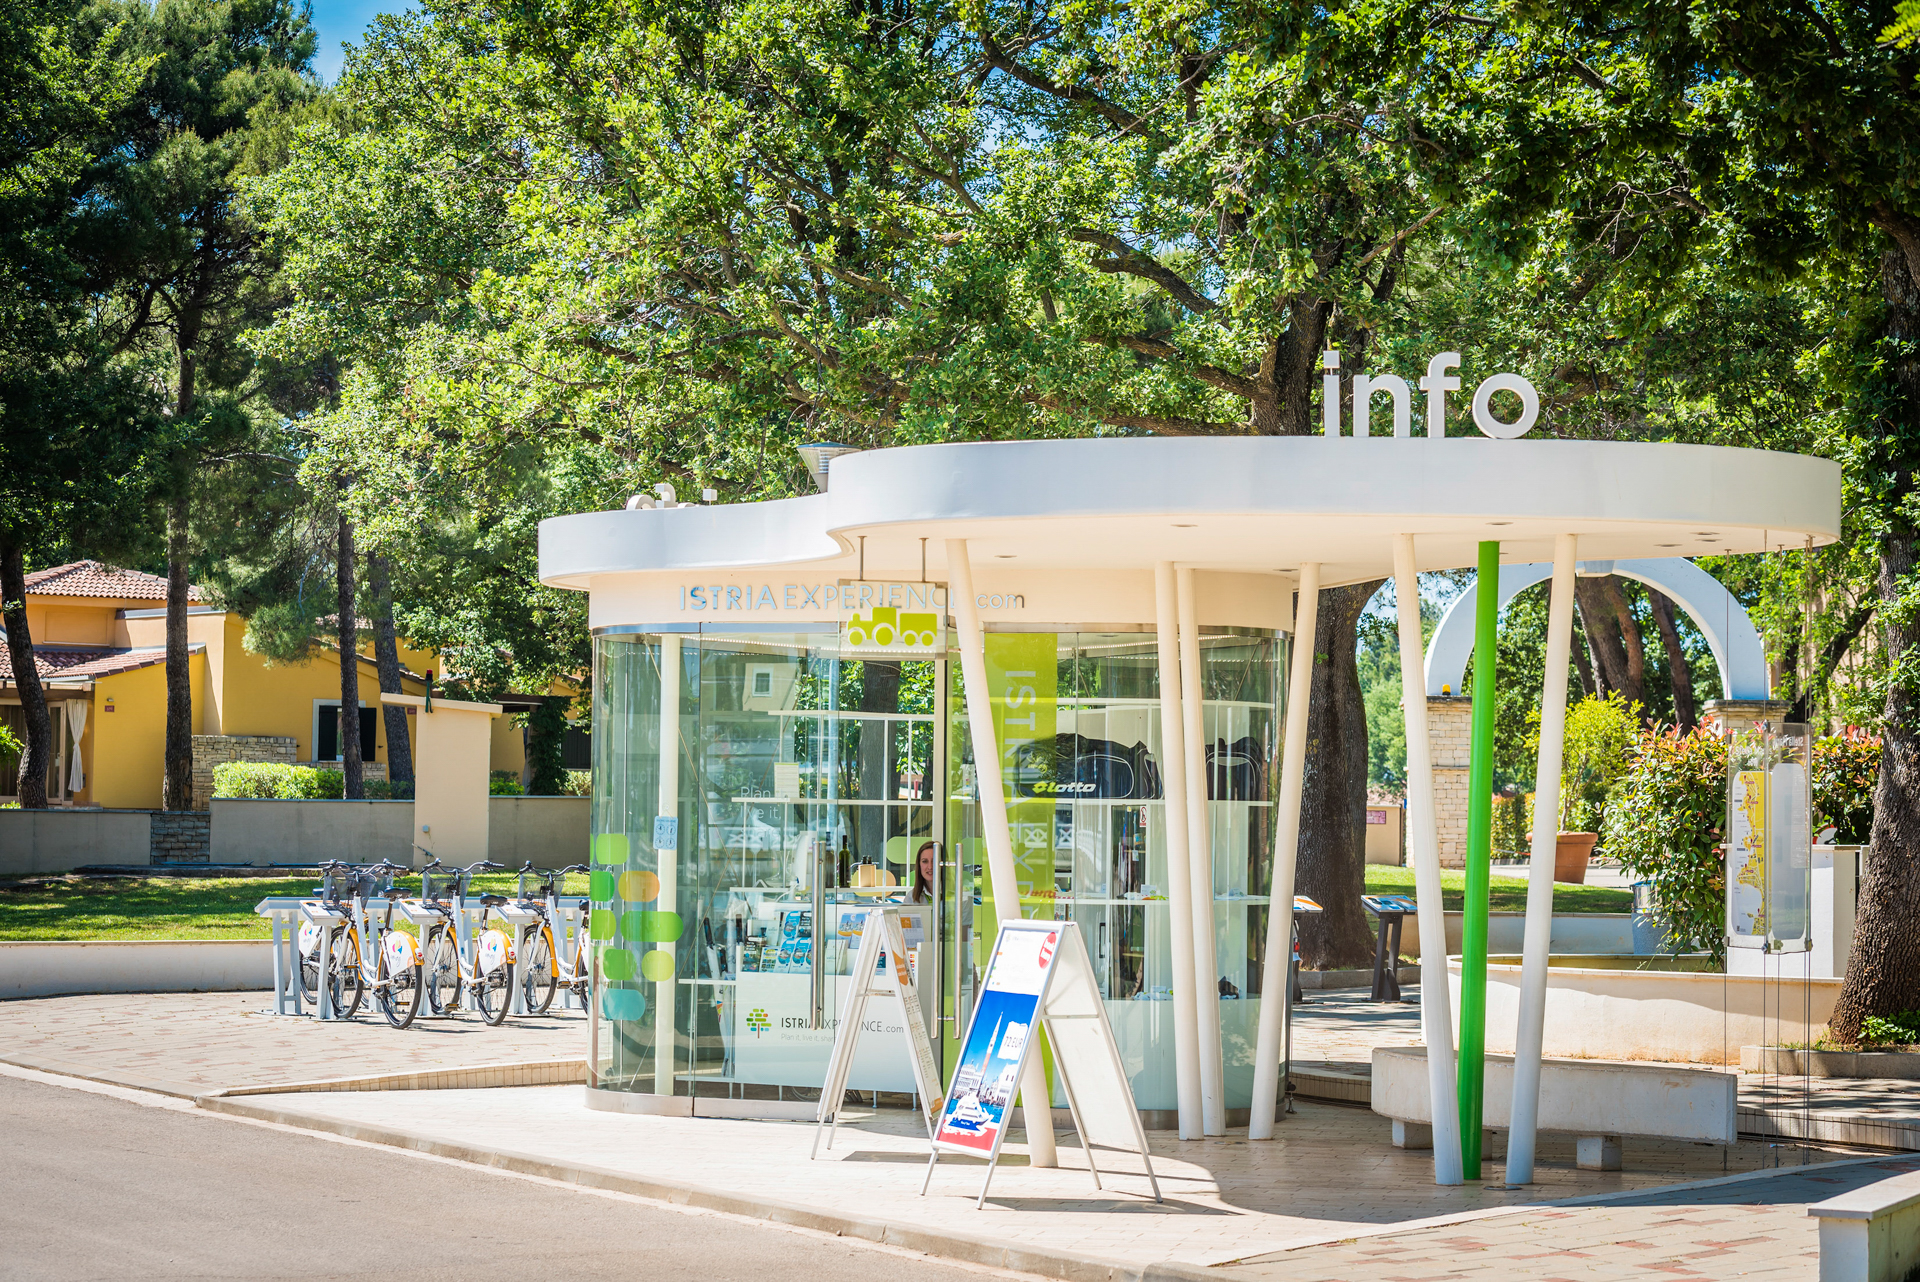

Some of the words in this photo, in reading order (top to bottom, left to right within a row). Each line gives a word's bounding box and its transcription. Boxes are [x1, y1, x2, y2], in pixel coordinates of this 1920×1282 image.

[1323, 350, 1540, 439] info
[740, 786, 771, 799] Plan
[1046, 782, 1097, 793] lotto
[740, 805, 765, 819] lve
